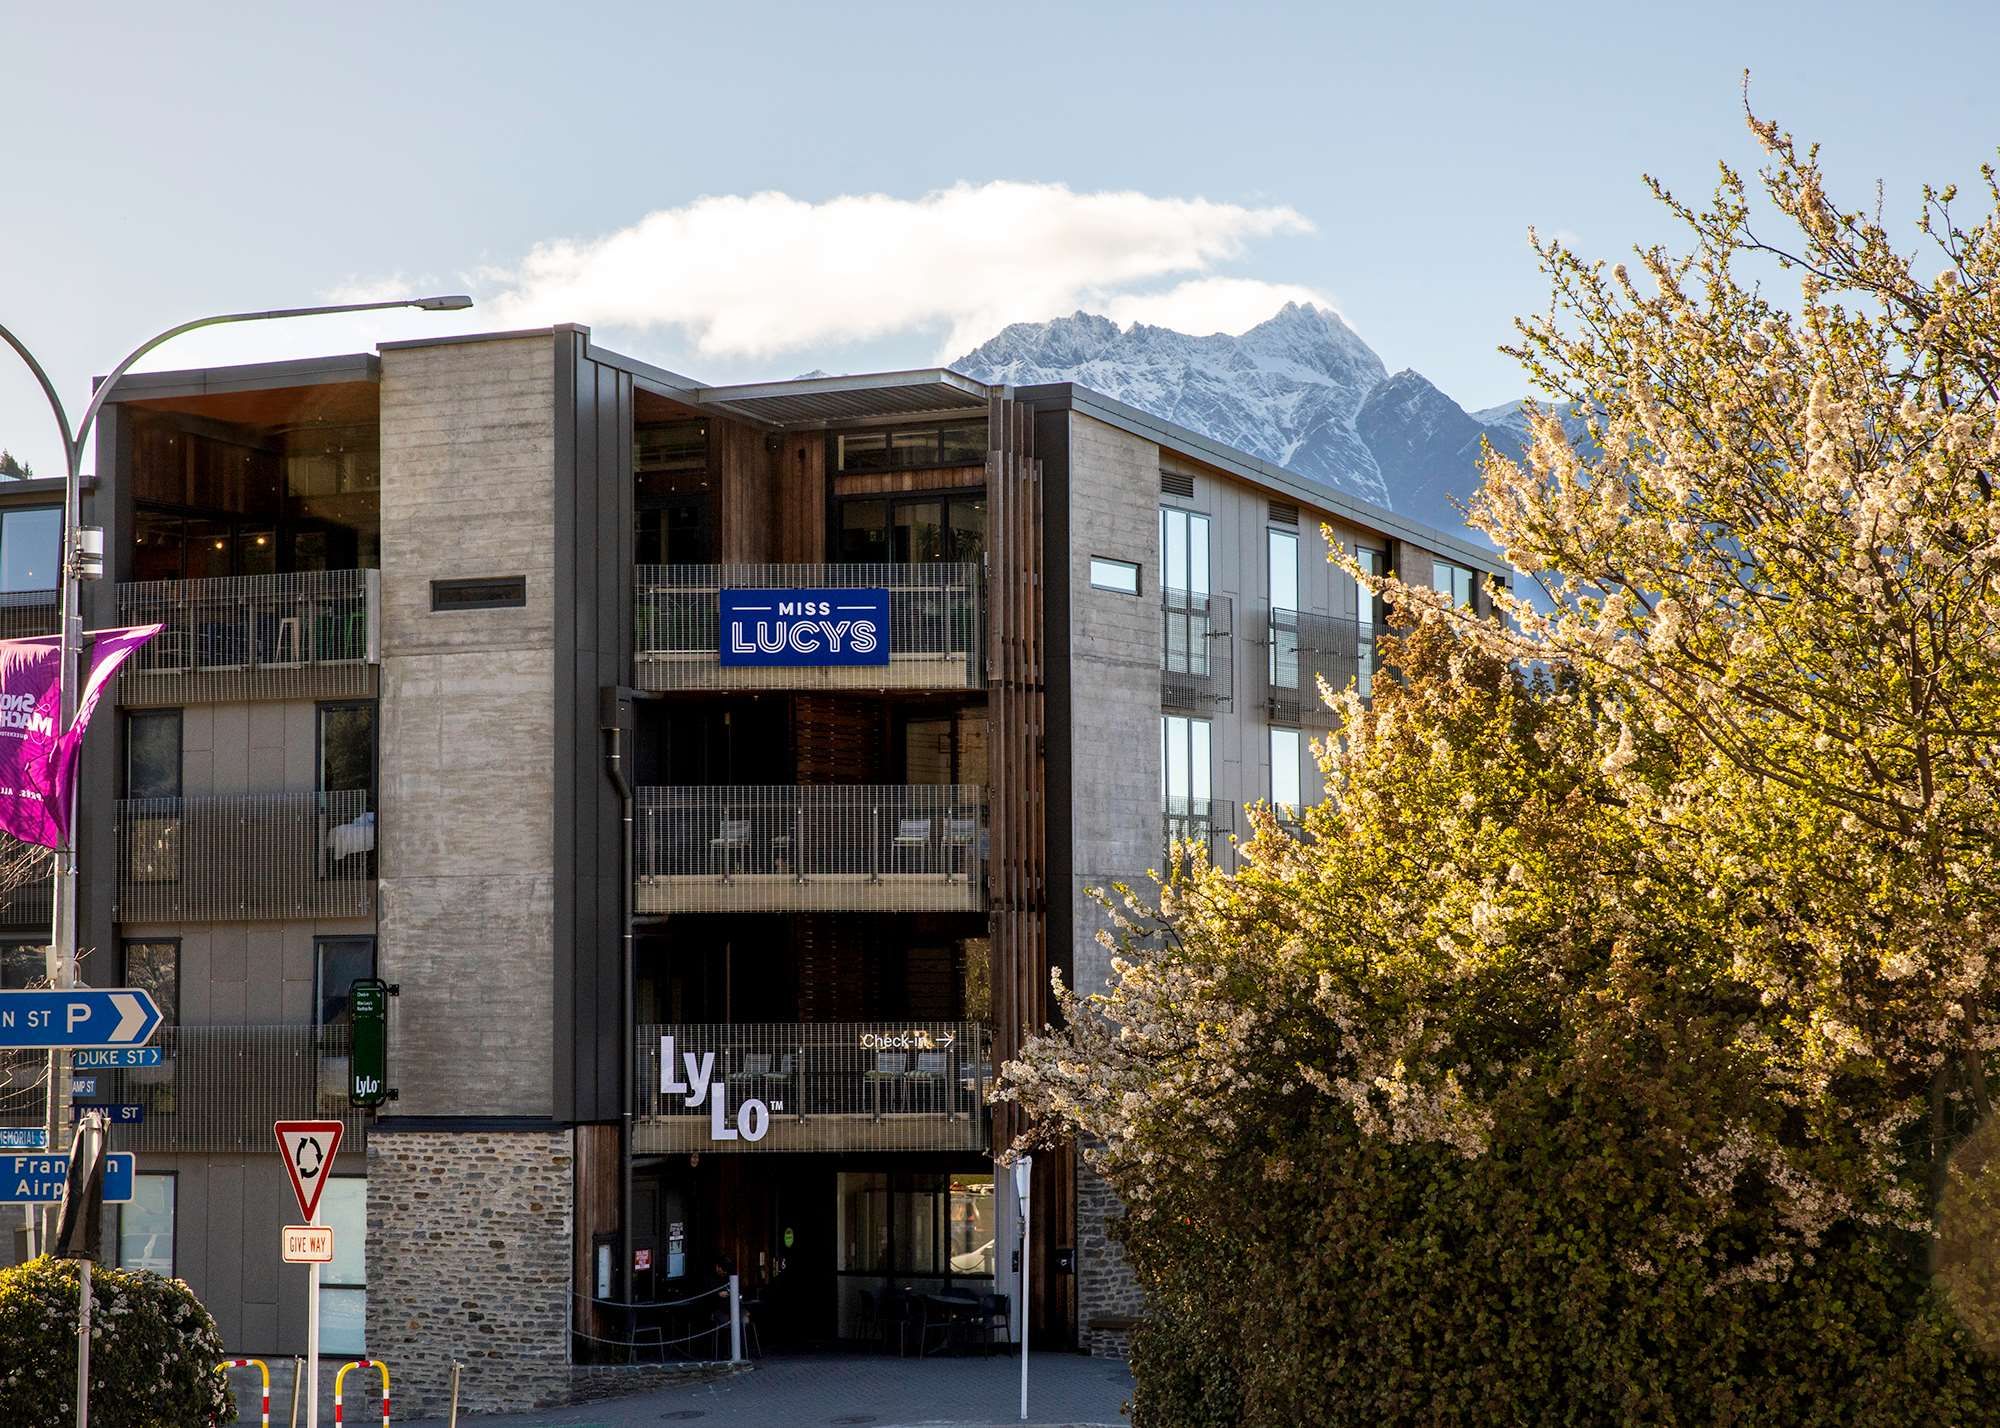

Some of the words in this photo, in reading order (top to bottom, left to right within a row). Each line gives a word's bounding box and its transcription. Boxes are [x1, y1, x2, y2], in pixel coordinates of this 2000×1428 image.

[779, 602, 831, 616] MISS
[732, 621, 877, 653] LUCYS
[27, 1010, 52, 1028] ST
[66, 1003, 92, 1034] P
[863, 1033, 928, 1048] Check-in
[79, 1050, 119, 1066] DUKE
[127, 1050, 146, 1064] ST
[86, 1081, 95, 1093] ST
[356, 1075, 378, 1098] LyLo
[121, 1107, 139, 1119] ST
[15, 1157, 118, 1174] Frann
[290, 1236, 307, 1253] GIVE
[310, 1236, 326, 1253] WAY
